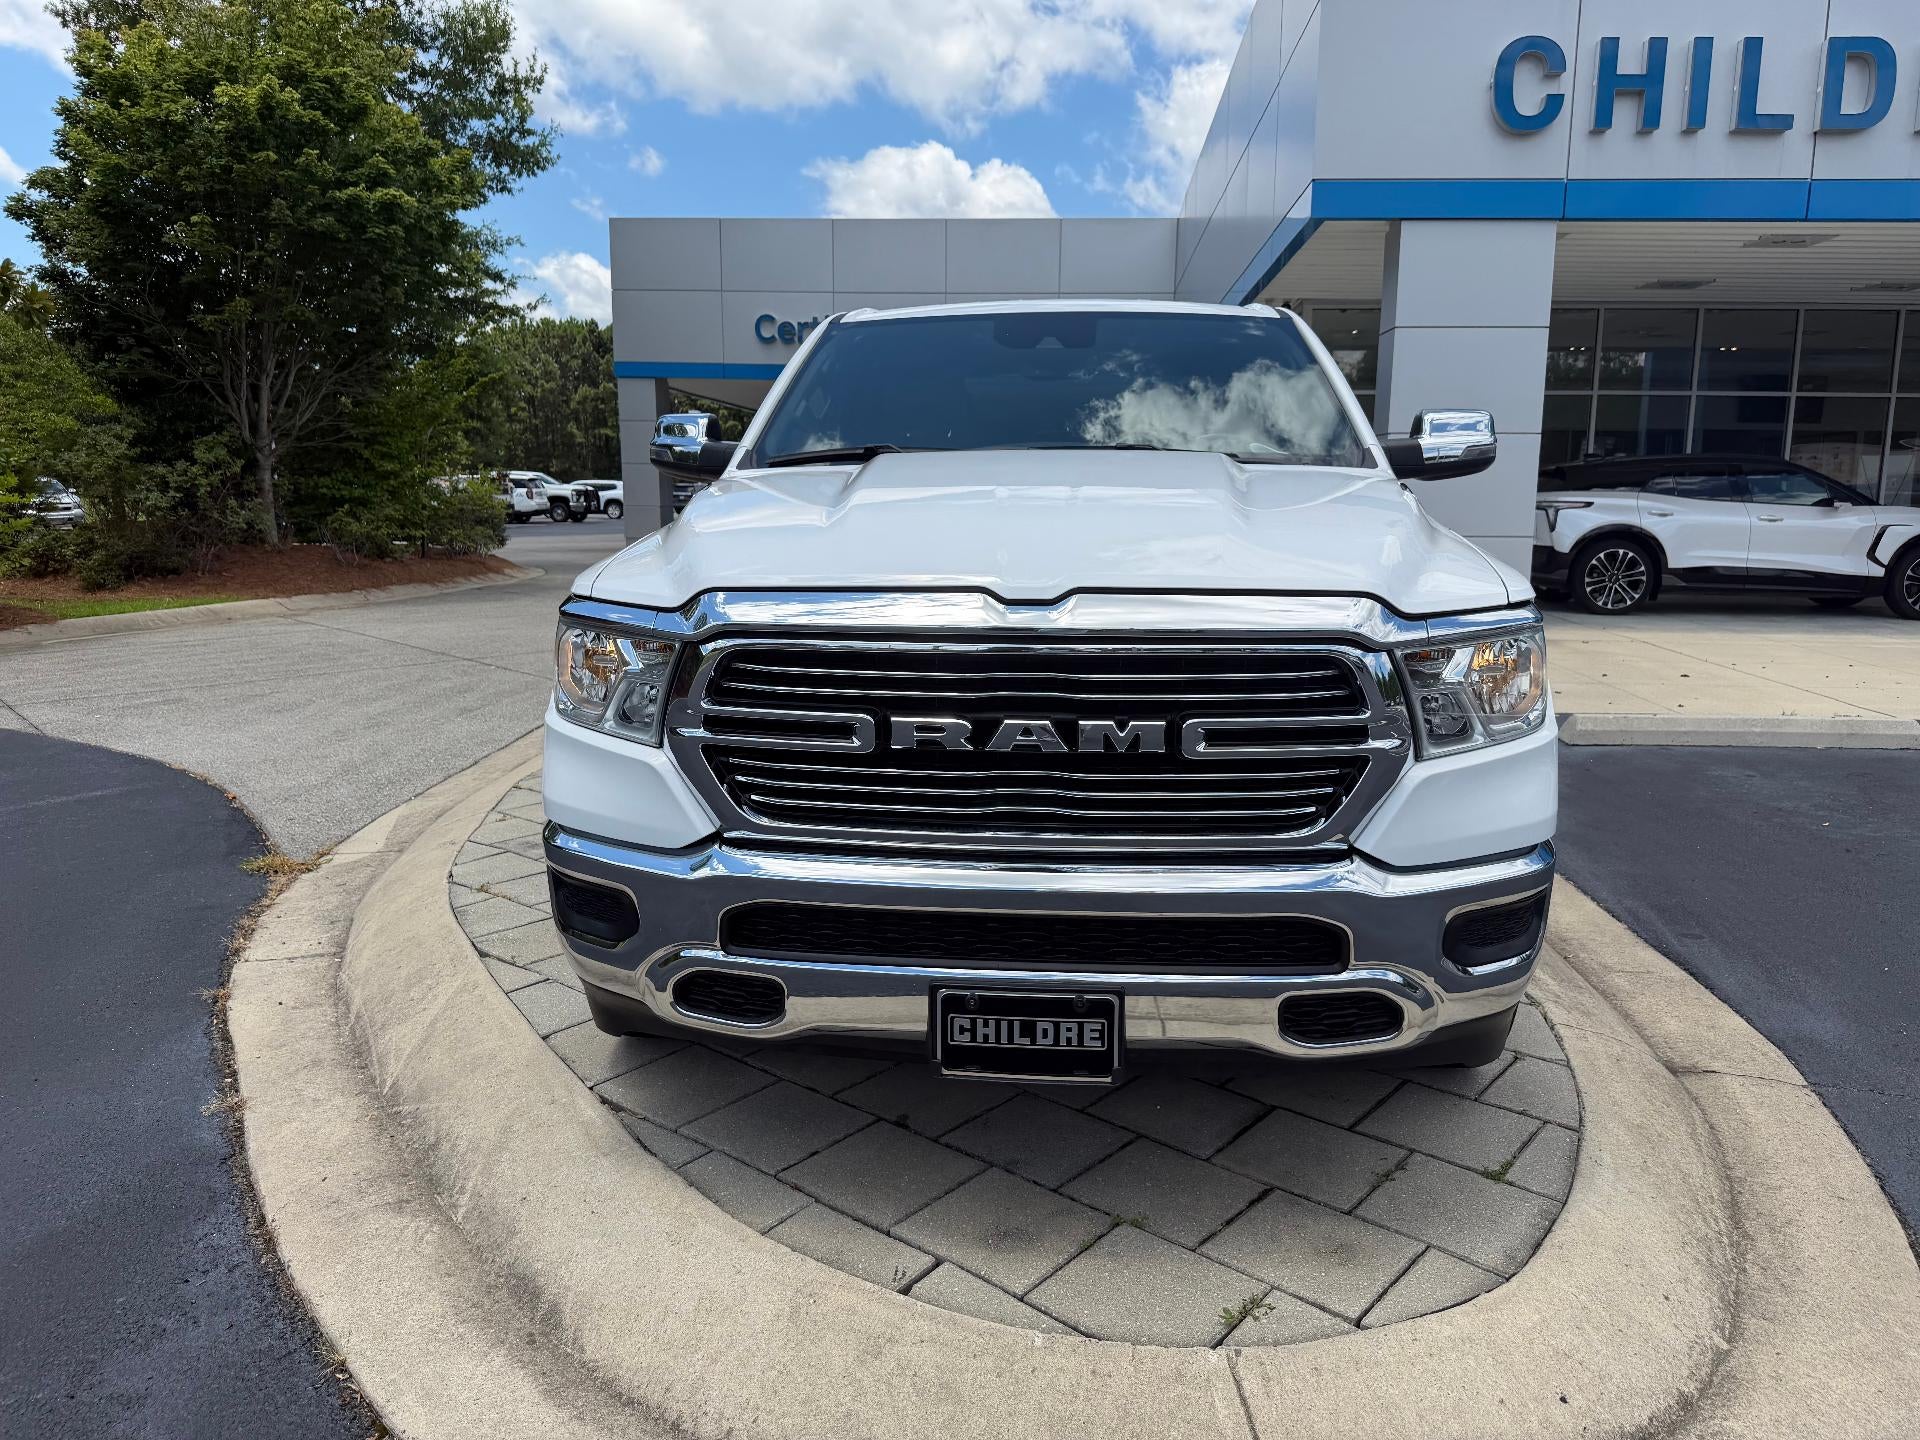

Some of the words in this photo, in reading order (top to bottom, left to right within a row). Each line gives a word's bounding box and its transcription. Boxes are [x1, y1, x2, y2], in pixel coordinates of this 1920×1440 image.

[1491, 35, 1920, 133] CHILD
[891, 717, 1166, 752] RAM
[953, 1017, 1102, 1047] CHILDRE
